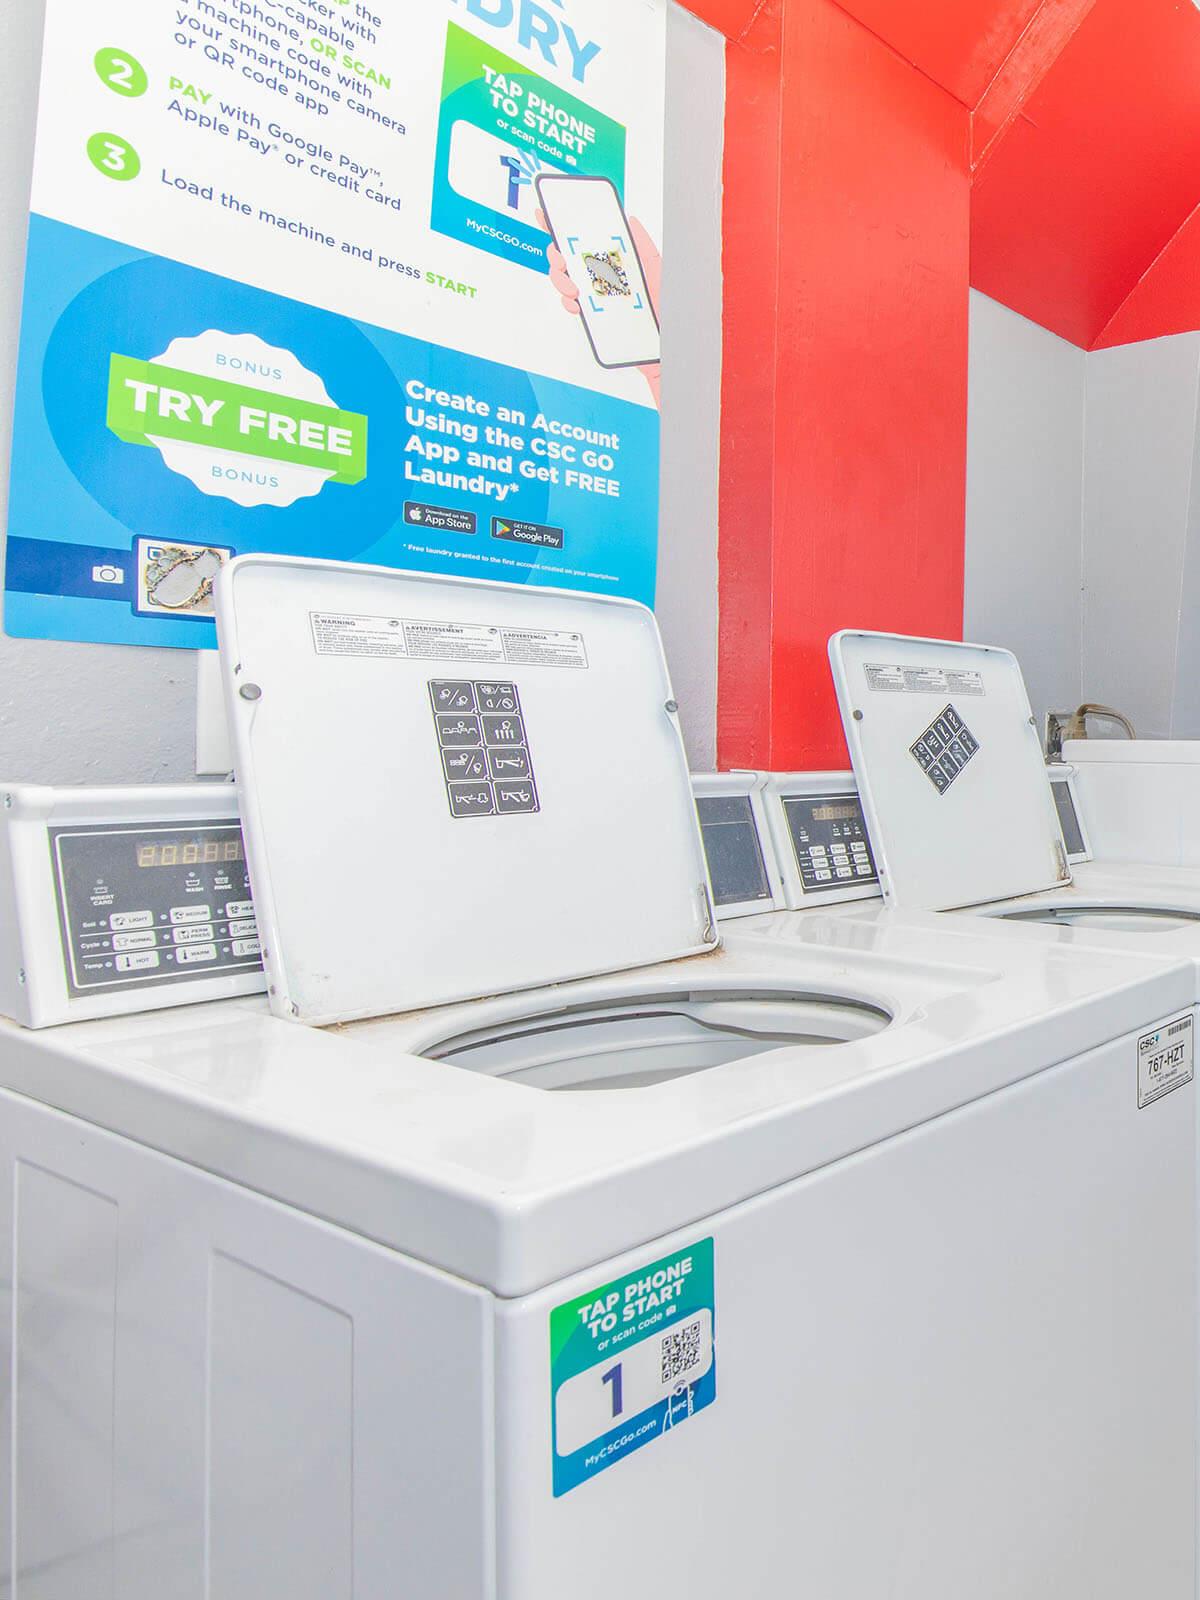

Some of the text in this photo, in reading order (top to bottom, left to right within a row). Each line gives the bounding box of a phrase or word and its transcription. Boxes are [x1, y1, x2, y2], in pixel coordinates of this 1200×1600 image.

[341, 16, 376, 44] with
[355, 4, 382, 28] the
[448, 0, 602, 83] DRY
[108, 58, 134, 89] 2
[174, 32, 329, 115] or QR code app
[176, 10, 407, 134] your smartphone camera
[197, 0, 373, 99] machine code with
[310, 38, 337, 61] OR
[343, 54, 392, 90] SCAN
[169, 76, 213, 105] PAY
[219, 102, 261, 129] with
[267, 123, 333, 161] Google
[482, 63, 596, 144] TAP PHONE
[489, 88, 588, 155] TO START
[101, 141, 126, 171] 3
[167, 100, 230, 136] Apple
[284, 153, 305, 168] or
[310, 163, 361, 193] credit
[365, 188, 402, 211] card
[496, 118, 563, 158] or scan code
[161, 169, 477, 298] Load the machine and press START
[466, 217, 543, 257] MyCSCGO.com
[215, 353, 283, 380] BONUS
[124, 378, 353, 457] TRY FREE
[405, 380, 620, 450] Create an Account
[405, 405, 615, 472] Using the CSC GO
[211, 465, 280, 488] BONUS
[404, 434, 620, 497] App and Get FREE
[425, 514, 472, 530] App Store
[513, 529, 560, 546] Google Play
[1140, 1036, 1155, 1050] CSC
[577, 1256, 693, 1325] TAP PHONE
[587, 1278, 685, 1339] TO START
[597, 1313, 663, 1352] or scan code
[601, 1362, 623, 1419] 1
[584, 1418, 657, 1468] MyCSCGo.com
